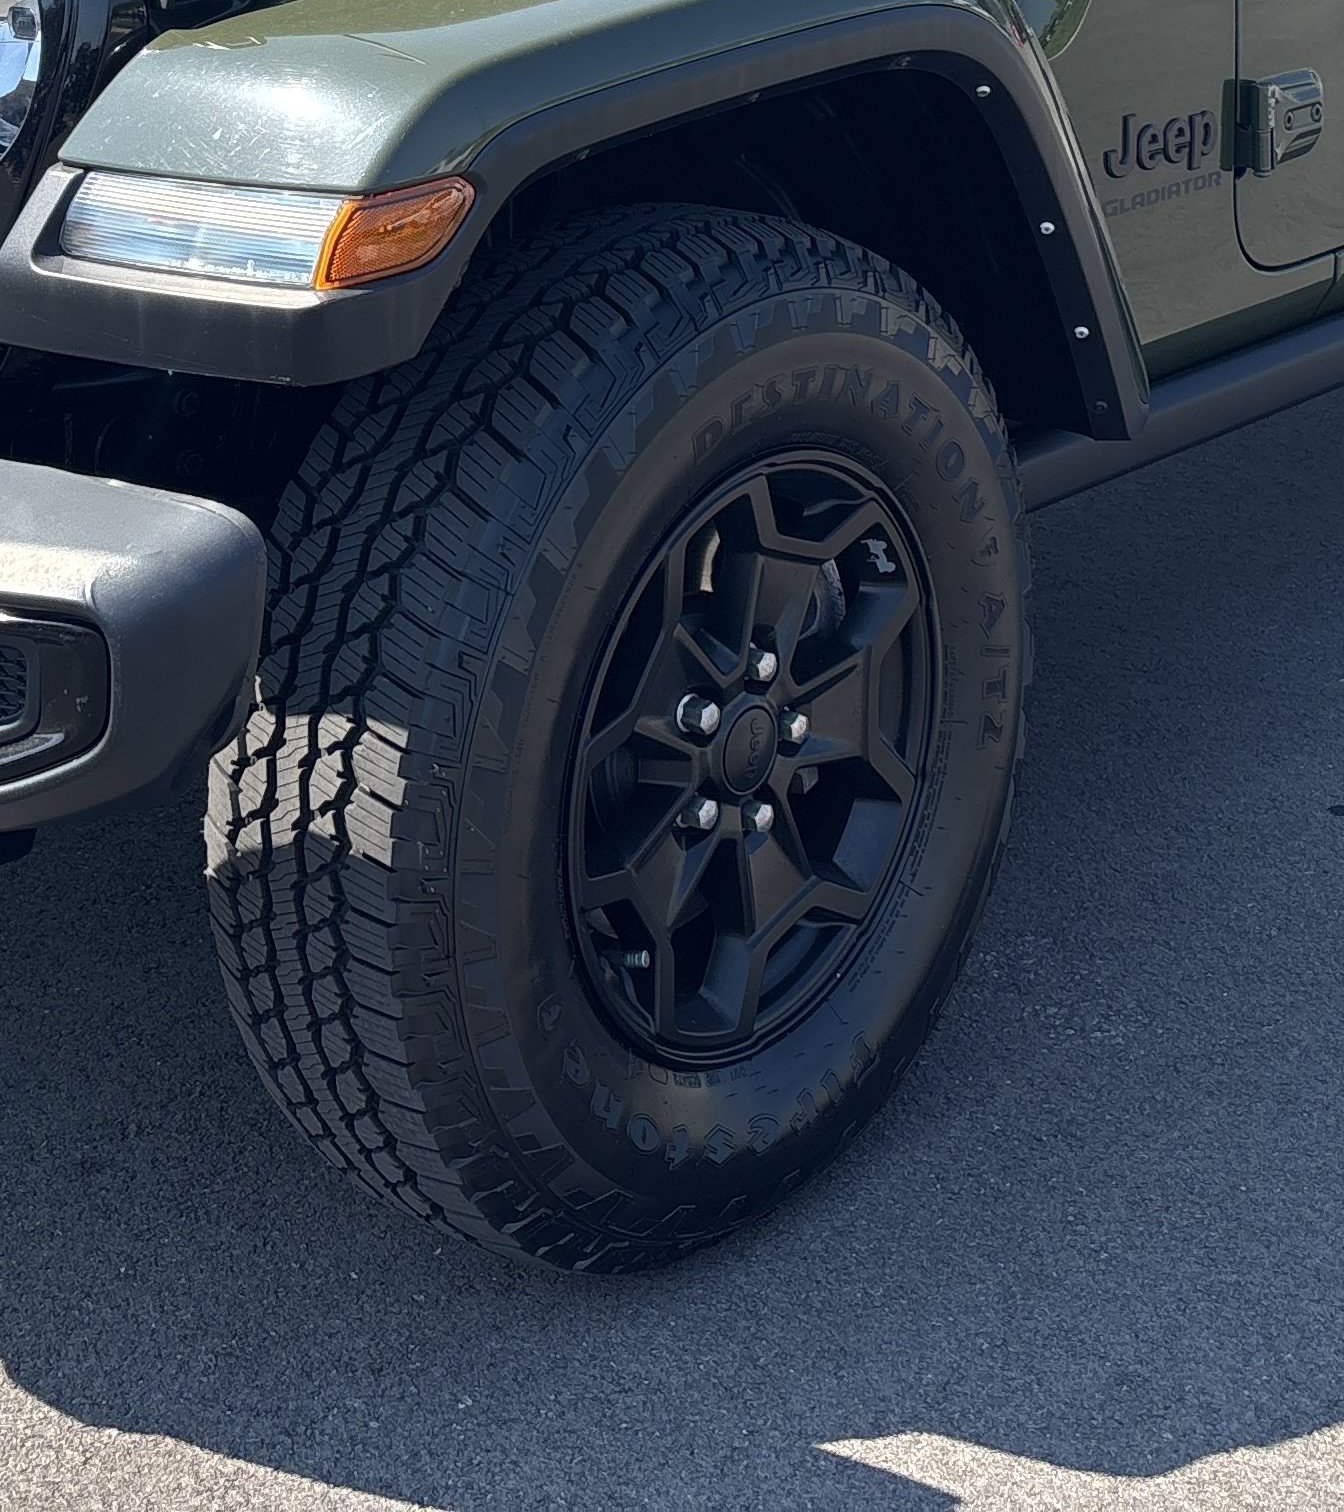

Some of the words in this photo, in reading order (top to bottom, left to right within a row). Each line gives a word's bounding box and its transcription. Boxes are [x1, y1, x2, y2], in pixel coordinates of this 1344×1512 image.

[1103, 109, 1218, 178] Jeep
[1106, 169, 1222, 218] GLADIATOR
[691, 364, 988, 525] DESTINATION
